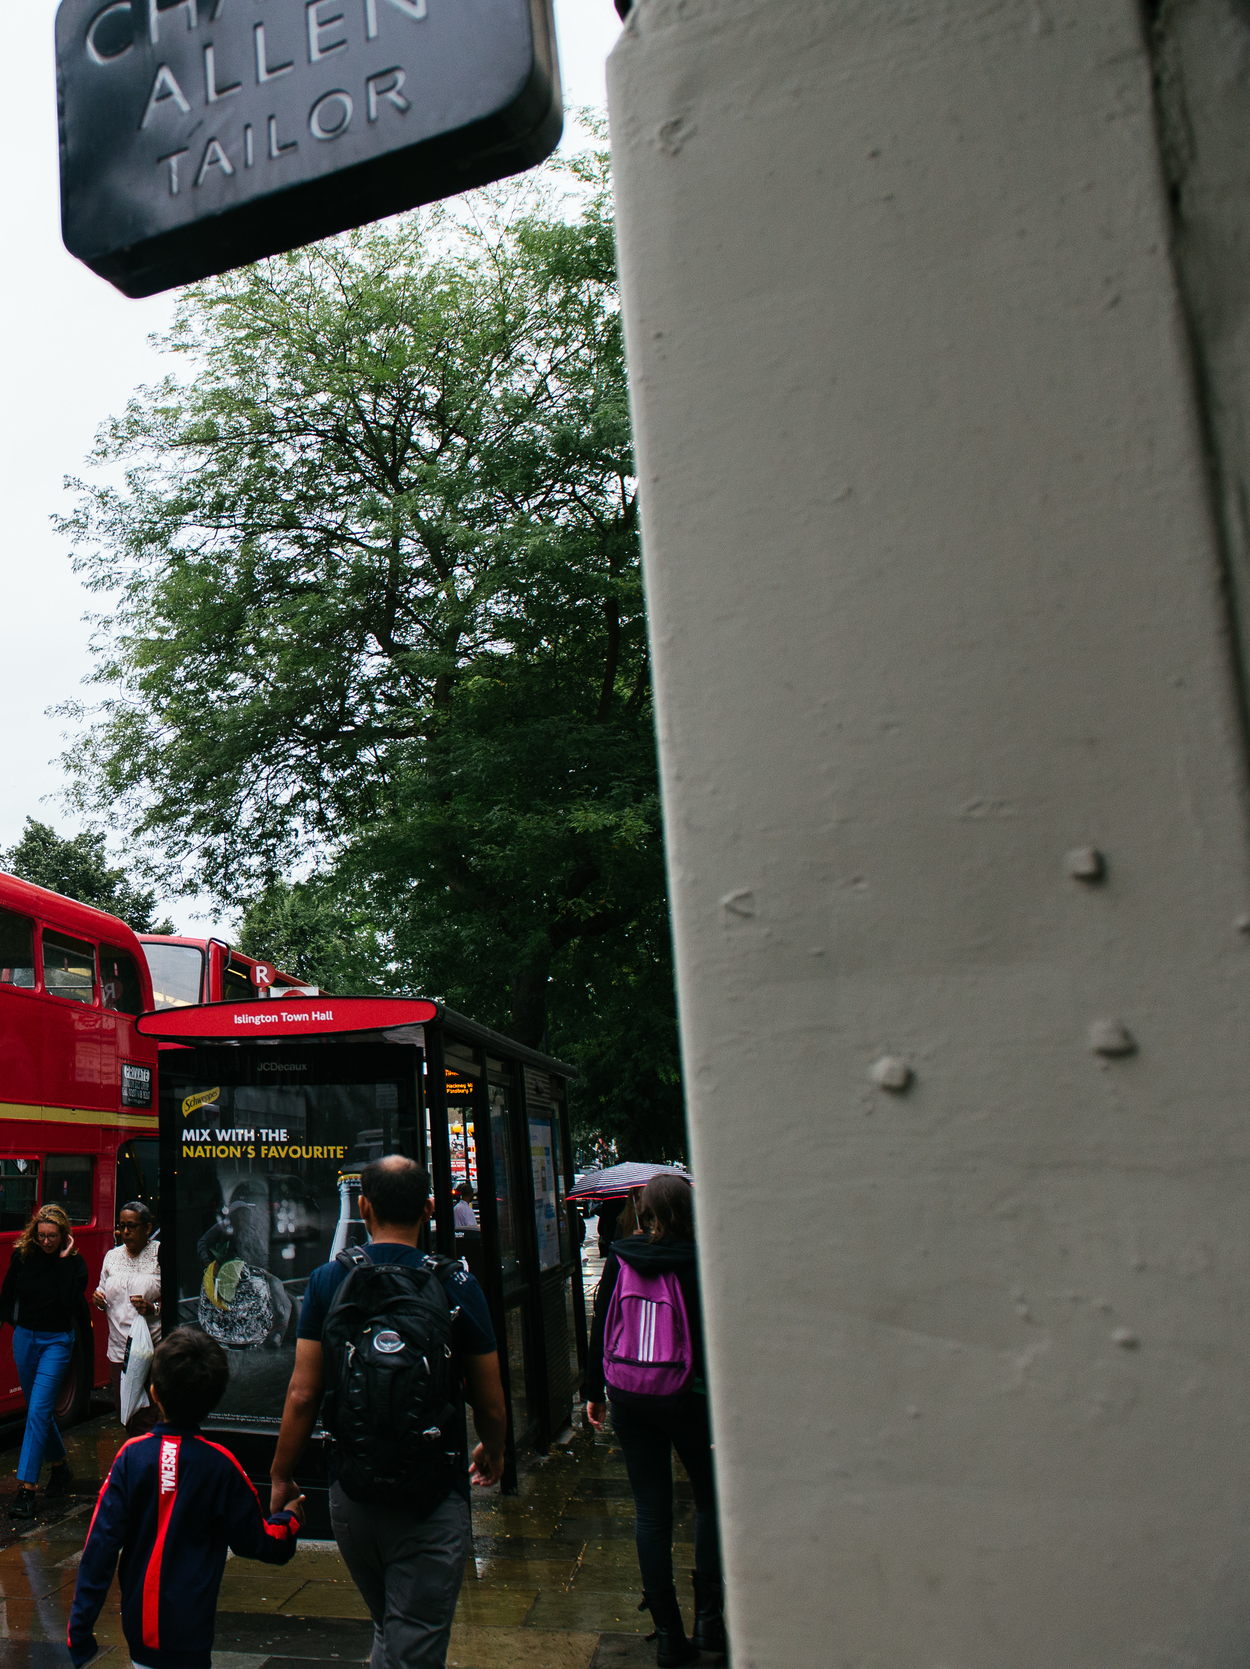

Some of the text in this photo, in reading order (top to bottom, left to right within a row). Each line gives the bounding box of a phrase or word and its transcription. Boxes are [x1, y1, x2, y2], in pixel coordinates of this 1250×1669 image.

[86, 0, 222, 66] CH
[140, 0, 429, 129] ALLEN
[156, 66, 410, 195] TAILOR
[256, 966, 269, 983] R
[234, 1010, 333, 1026] Islington Town Hall
[125, 1066, 150, 1082] PRIVATE
[257, 1062, 307, 1071] JCDecaux
[184, 1090, 218, 1112] Schweppes
[182, 1129, 288, 1142] MIX WITH THE
[182, 1145, 256, 1158] NATION'S
[161, 1440, 178, 1495] ARSENAL
